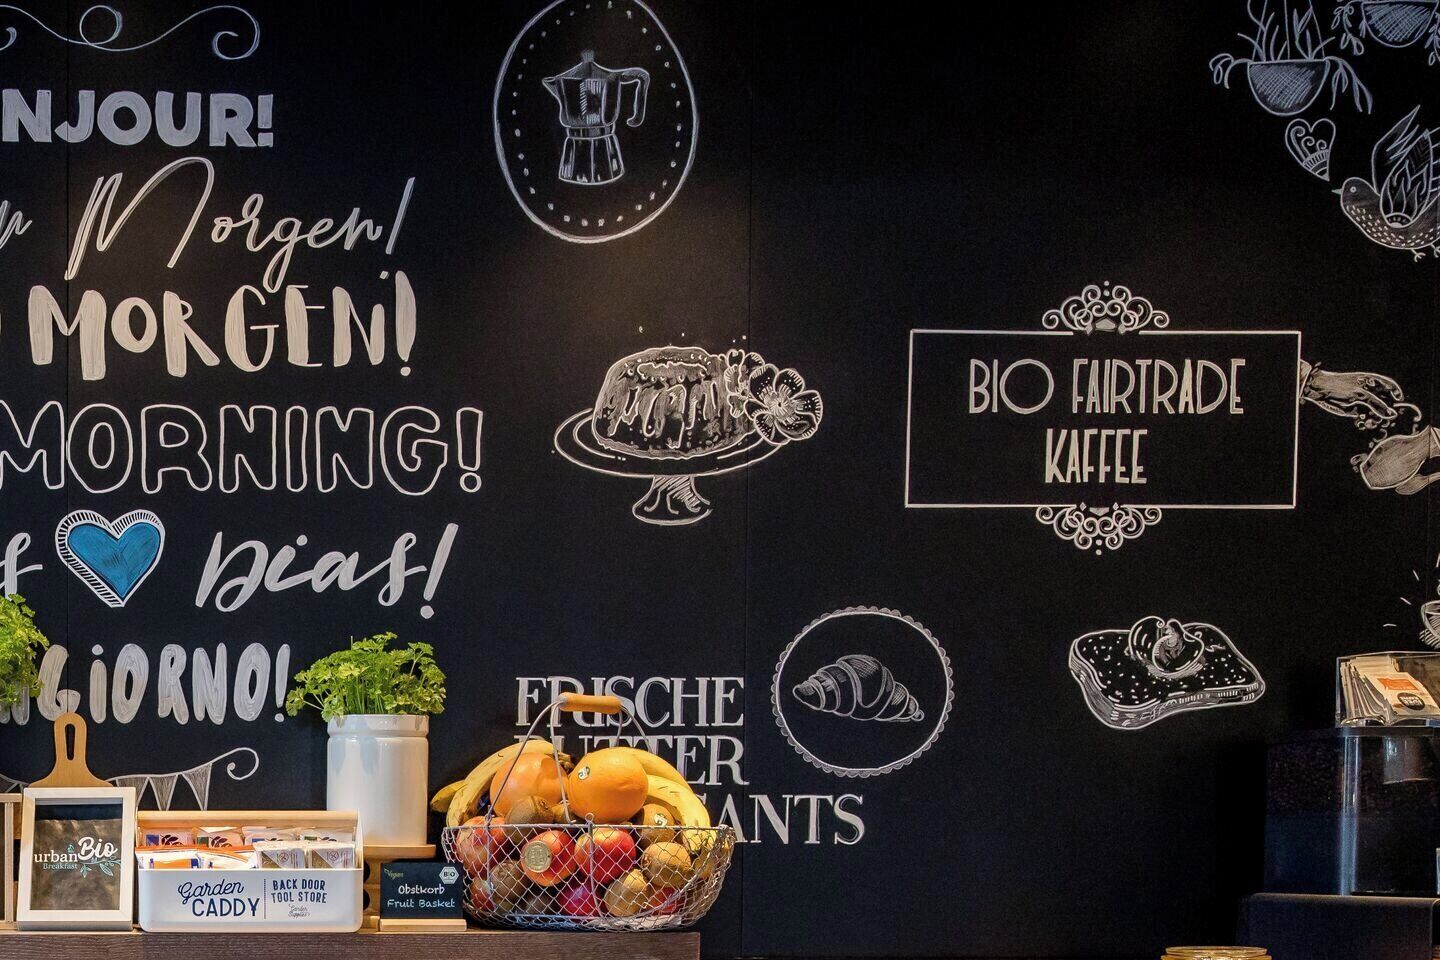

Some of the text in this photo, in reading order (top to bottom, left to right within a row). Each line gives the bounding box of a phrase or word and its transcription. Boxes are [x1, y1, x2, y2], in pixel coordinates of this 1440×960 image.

[65, 156, 416, 292] Morgen!
[28, 270, 418, 381] MORGEN!
[970, 359, 1247, 416] BIO FAIRTRADE
[1044, 429, 1149, 485] KAFFEE
[196, 522, 459, 620] Dias!
[515, 676, 745, 727] FRISCHE
[34, 836, 118, 862] urban Bio
[43, 862, 78, 870] Breakfast
[177, 878, 244, 904] Garden
[272, 878, 326, 891] BACK DOOR
[398, 883, 445, 894] Obstkorb
[191, 897, 260, 917] CADDY
[271, 892, 327, 904] TOOL STORE
[387, 898, 455, 908] Fruit Basket
